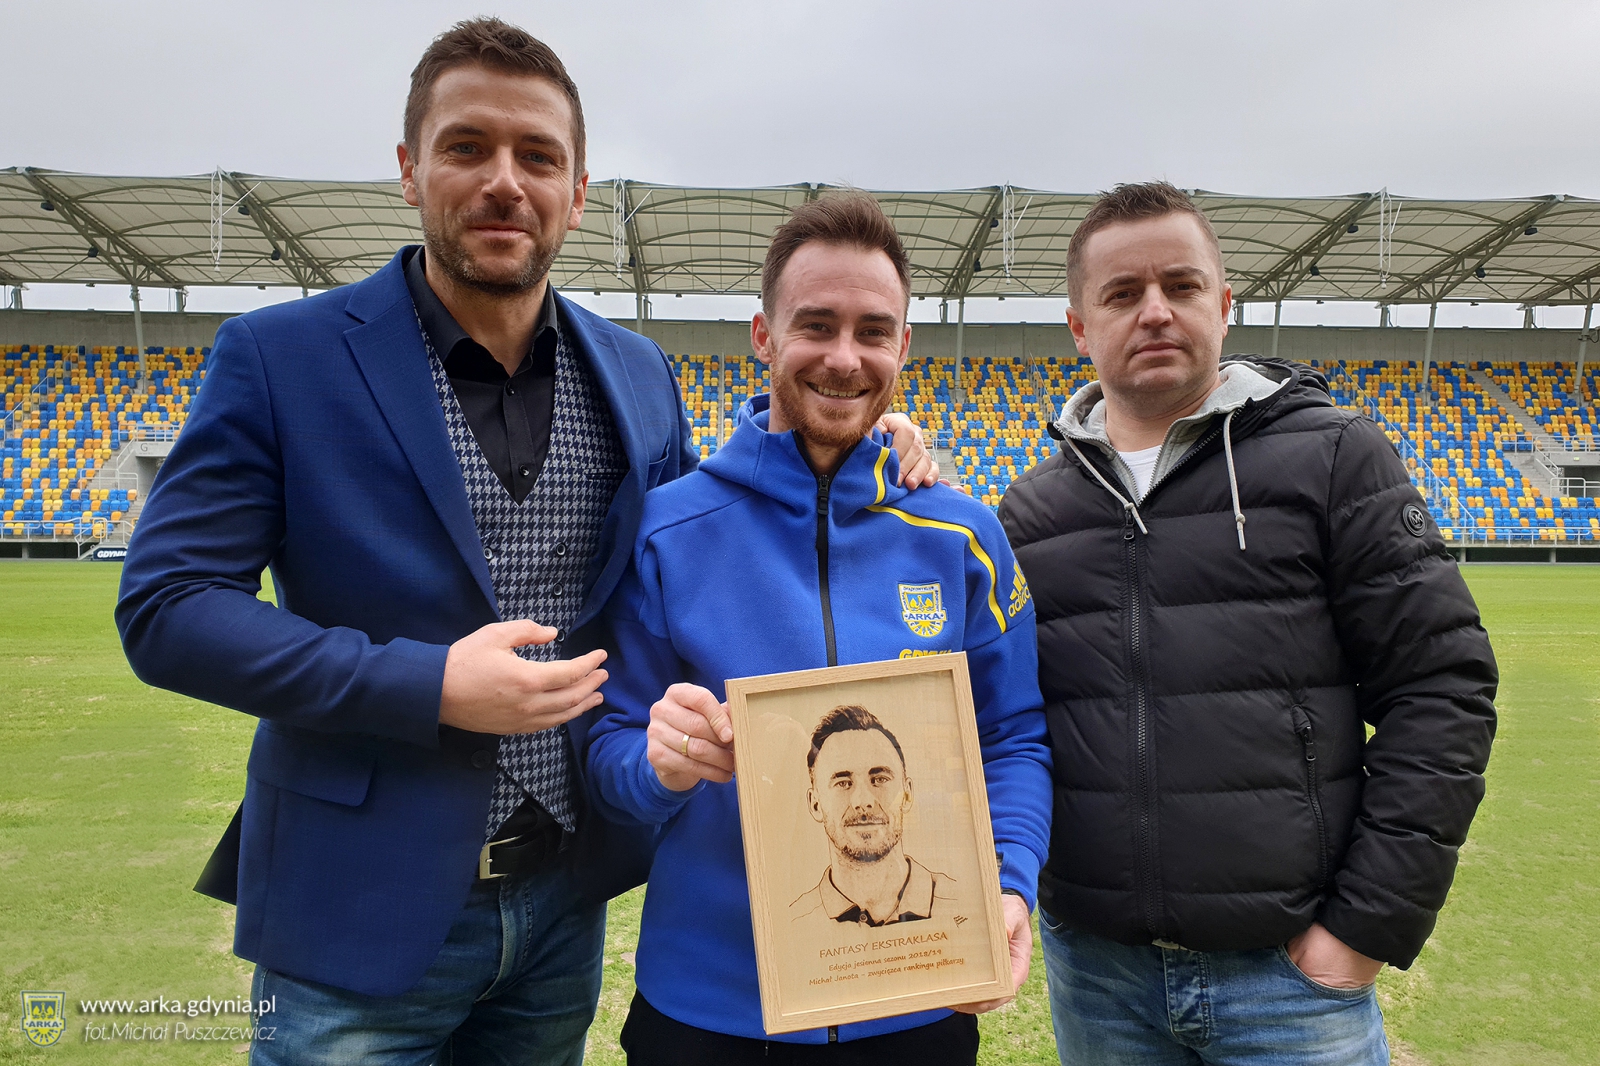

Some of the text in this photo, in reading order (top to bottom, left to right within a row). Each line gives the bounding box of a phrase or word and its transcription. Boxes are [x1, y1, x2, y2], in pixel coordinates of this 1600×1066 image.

[907, 613, 941, 621] ARKA
[819, 931, 949, 959] FANTASY EKSTRAKLASA
[809, 975, 833, 986] Michał
[834, 973, 859, 982] Janota
[903, 962, 935, 971] rankingu
[936, 957, 965, 969] piłkarzy
[828, 948, 942, 972] Edycja jesienna sezonu 2018/19
